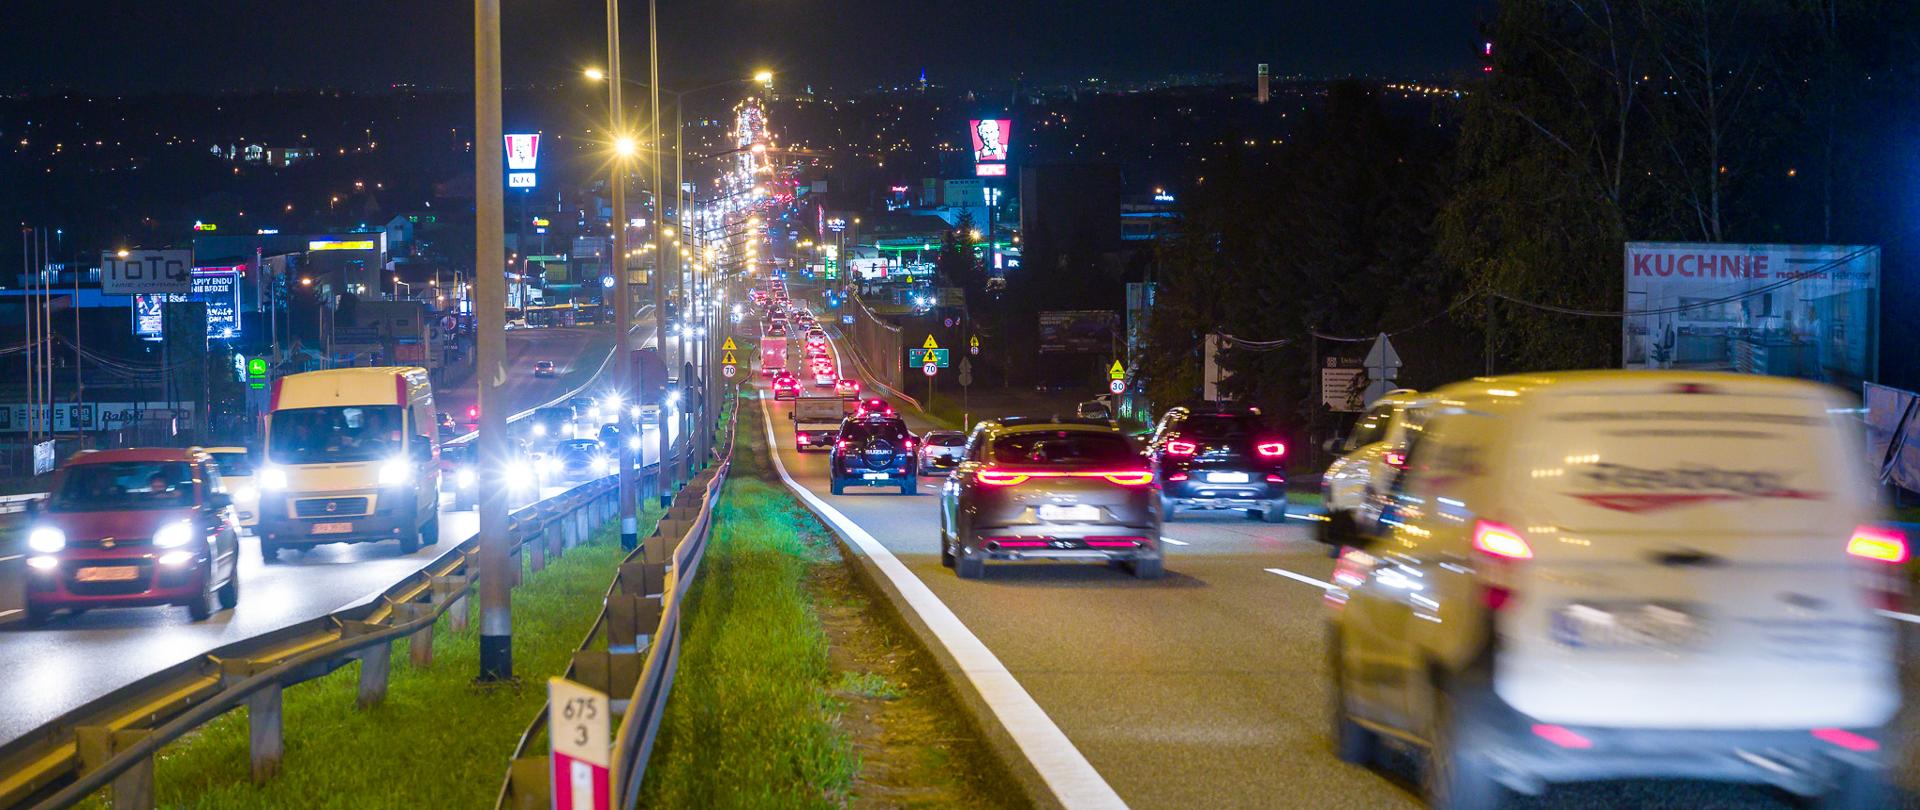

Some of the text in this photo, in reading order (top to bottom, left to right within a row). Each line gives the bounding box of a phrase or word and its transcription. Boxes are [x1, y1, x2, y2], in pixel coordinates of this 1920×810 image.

[1633, 253, 1769, 279] KUCHNIE
[191, 277, 233, 286] APPY ENDU
[725, 367, 735, 375] 70
[925, 365, 936, 374] 70
[1112, 382, 1124, 391] 30
[864, 448, 893, 456] SUZUKI
[562, 698, 597, 720] 675
[573, 725, 590, 747] 3
